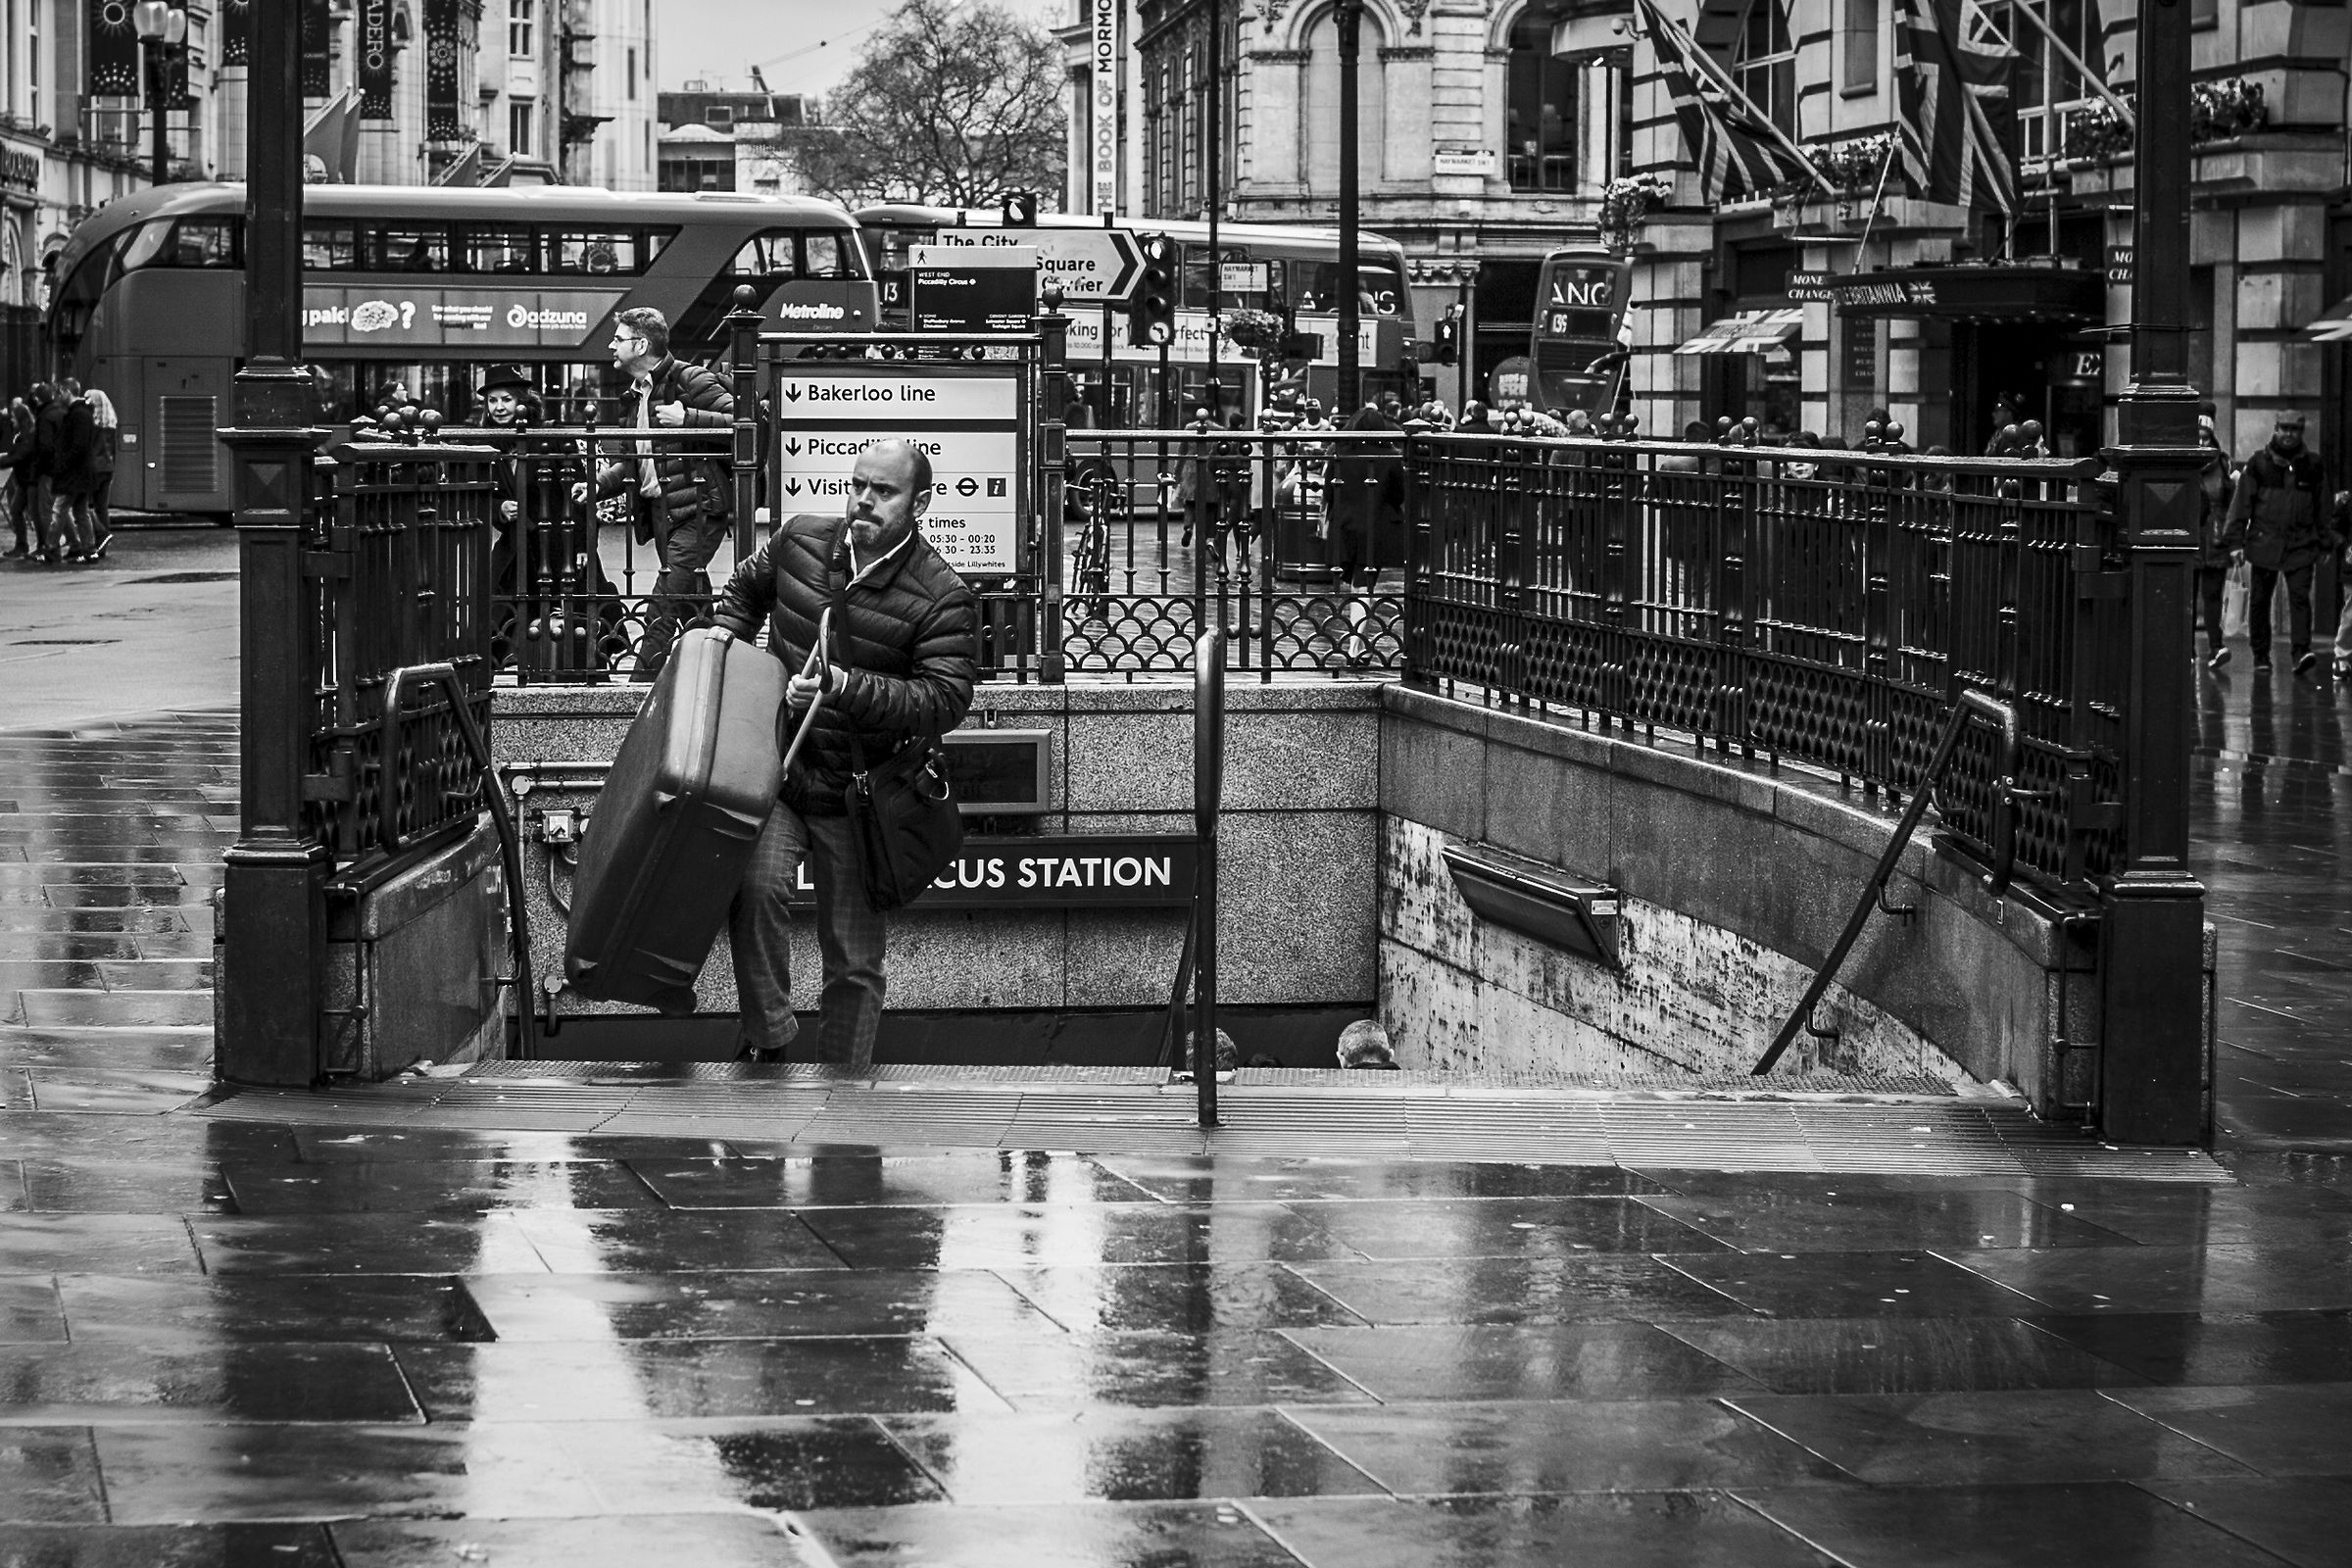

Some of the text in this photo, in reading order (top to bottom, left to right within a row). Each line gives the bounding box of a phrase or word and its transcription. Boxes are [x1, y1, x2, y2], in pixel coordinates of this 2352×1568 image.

[1098, 79, 1112, 107] OF
[1098, 115, 1112, 172] BOOK
[943, 235, 975, 247] The
[1037, 256, 1096, 273] Square
[1792, 274, 1826, 285] MONE
[884, 282, 898, 302] 13
[309, 306, 349, 326] paid
[527, 309, 587, 323] adzuna
[780, 303, 845, 319] Metroline
[1066, 321, 1098, 340] king
[808, 384, 935, 401] Bakerloo line
[906, 438, 941, 455] ine
[808, 478, 852, 495] Visit
[928, 517, 966, 528] times
[929, 534, 957, 543] 05:30
[967, 534, 996, 543] 00:20
[1017, 857, 1171, 888] STATION
